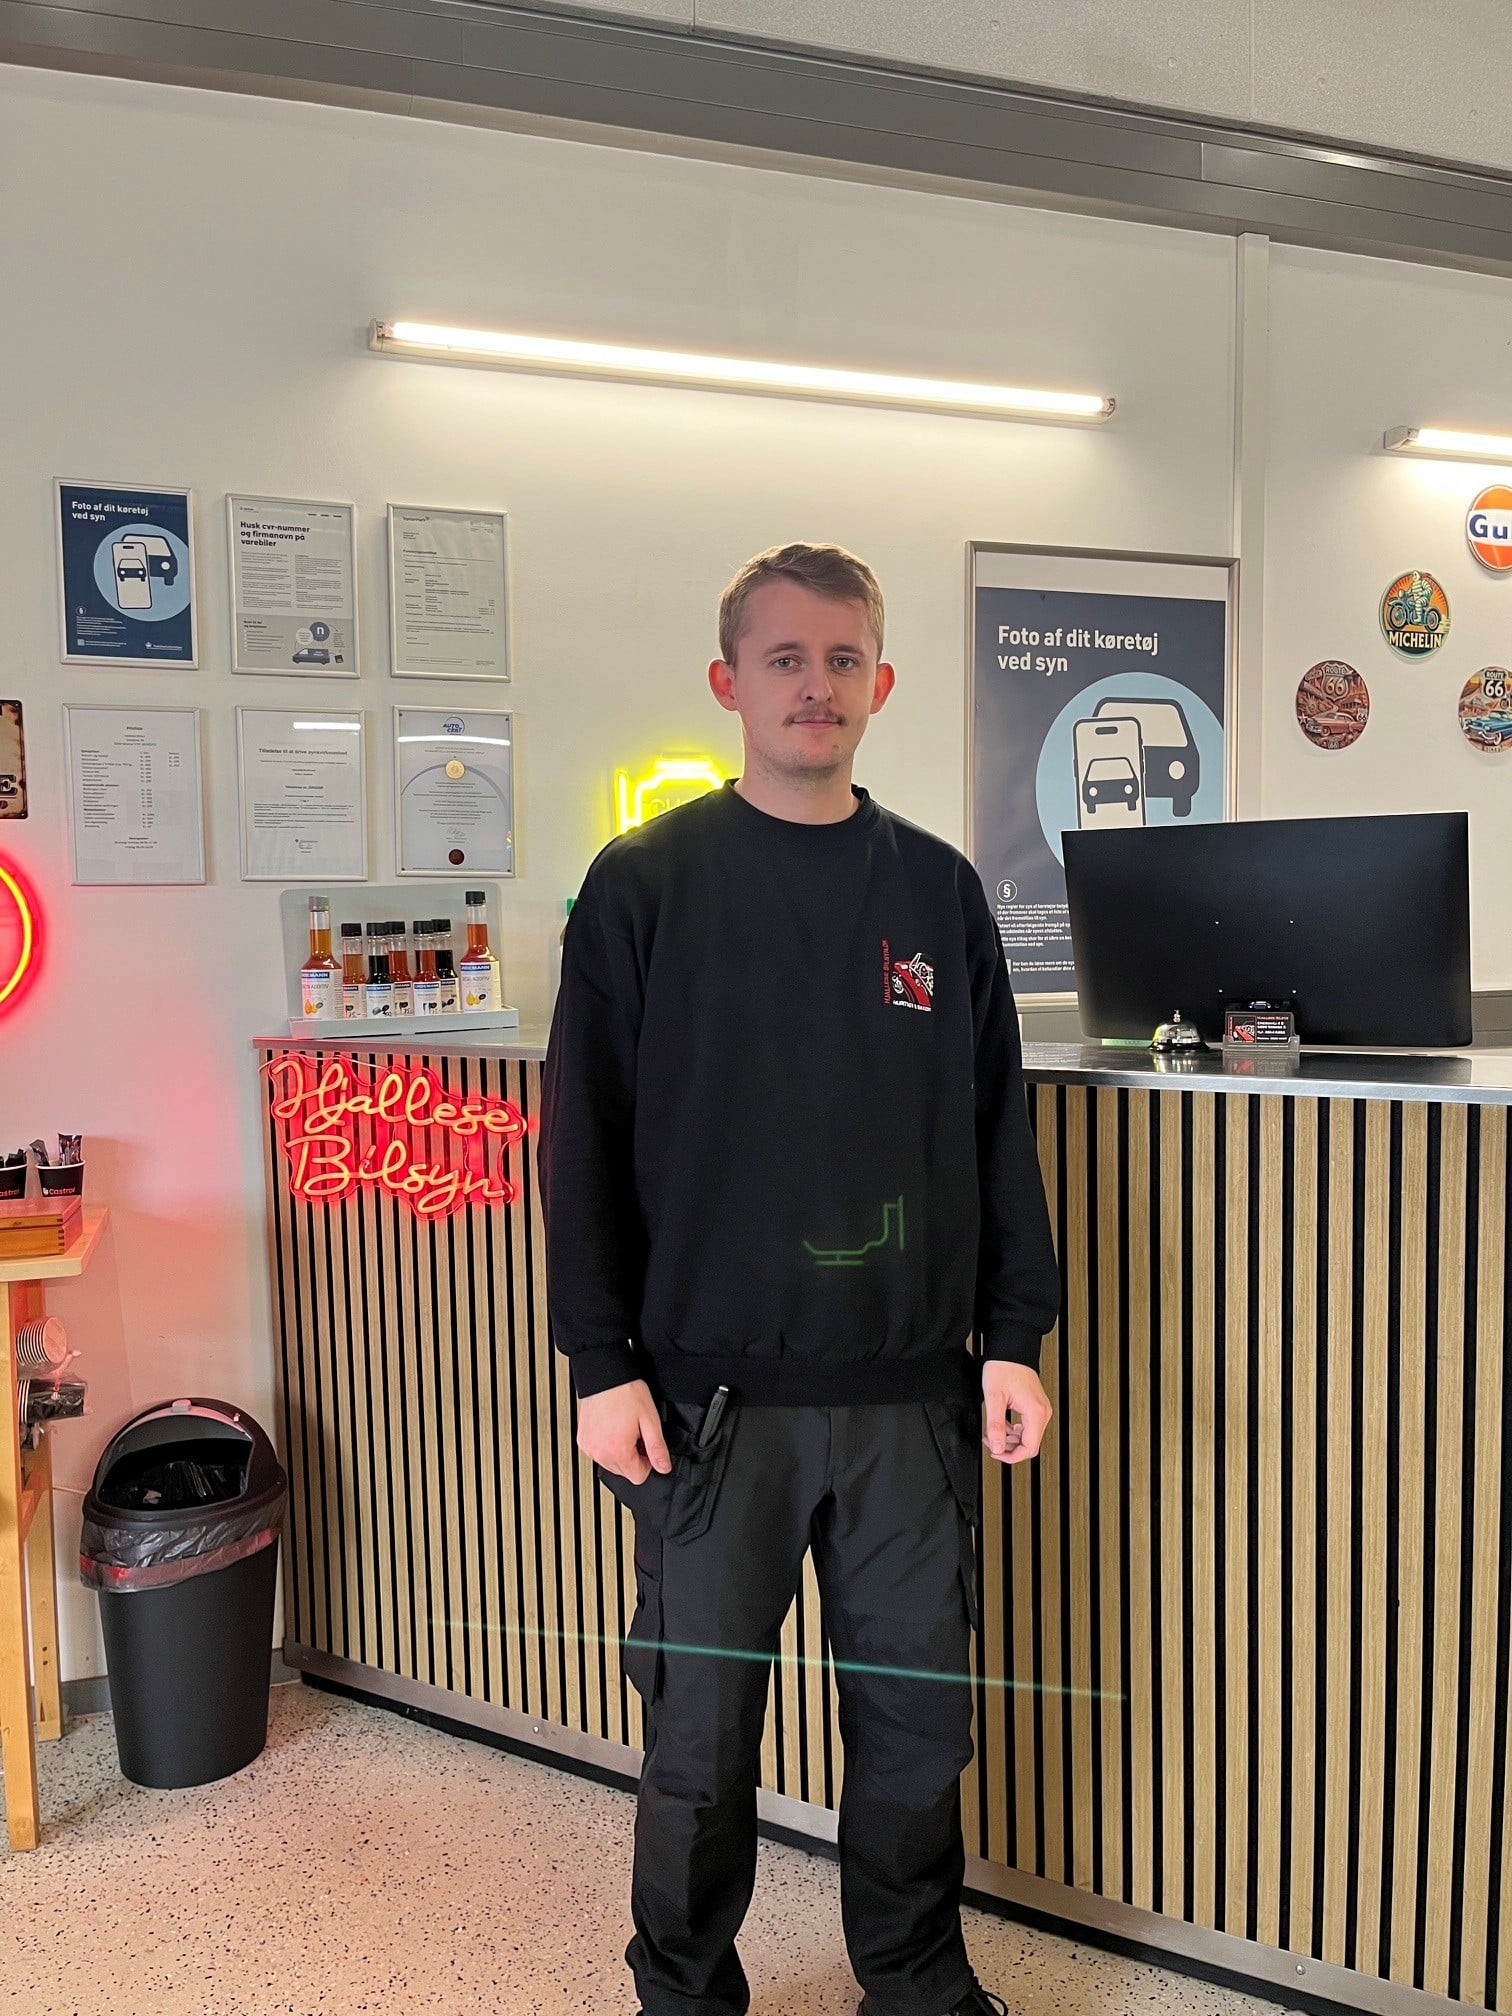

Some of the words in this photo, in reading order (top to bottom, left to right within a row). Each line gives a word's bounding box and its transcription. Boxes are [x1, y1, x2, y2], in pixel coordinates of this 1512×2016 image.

[72, 502, 92, 510] Foto
[93, 503, 102, 512] af
[104, 504, 115, 512] dit
[117, 505, 148, 516] køretøj
[72, 512, 88, 520] ved
[90, 514, 106, 522] syn
[240, 521, 260, 530] Husk
[262, 524, 310, 533] cvr-nummer
[1469, 514, 1512, 539] Gu
[241, 538, 276, 547] varebiler
[252, 530, 294, 540] firmanavn
[295, 532, 305, 541] på
[998, 625, 1040, 646] Foto
[1044, 628, 1063, 647] af
[1066, 630, 1091, 648] dit
[1094, 630, 1158, 656] køretøj
[1389, 631, 1442, 648] MICHELIN
[998, 652, 1030, 671] ved
[1035, 656, 1068, 676] syn
[1486, 671, 1504, 679] ROUTE
[1325, 677, 1345, 696] 66
[1485, 680, 1504, 697] 66
[272, 1060, 520, 1135] Hjallese
[285, 1134, 506, 1213] Bilsyn
[49, 1187, 76, 1195] Castrol
